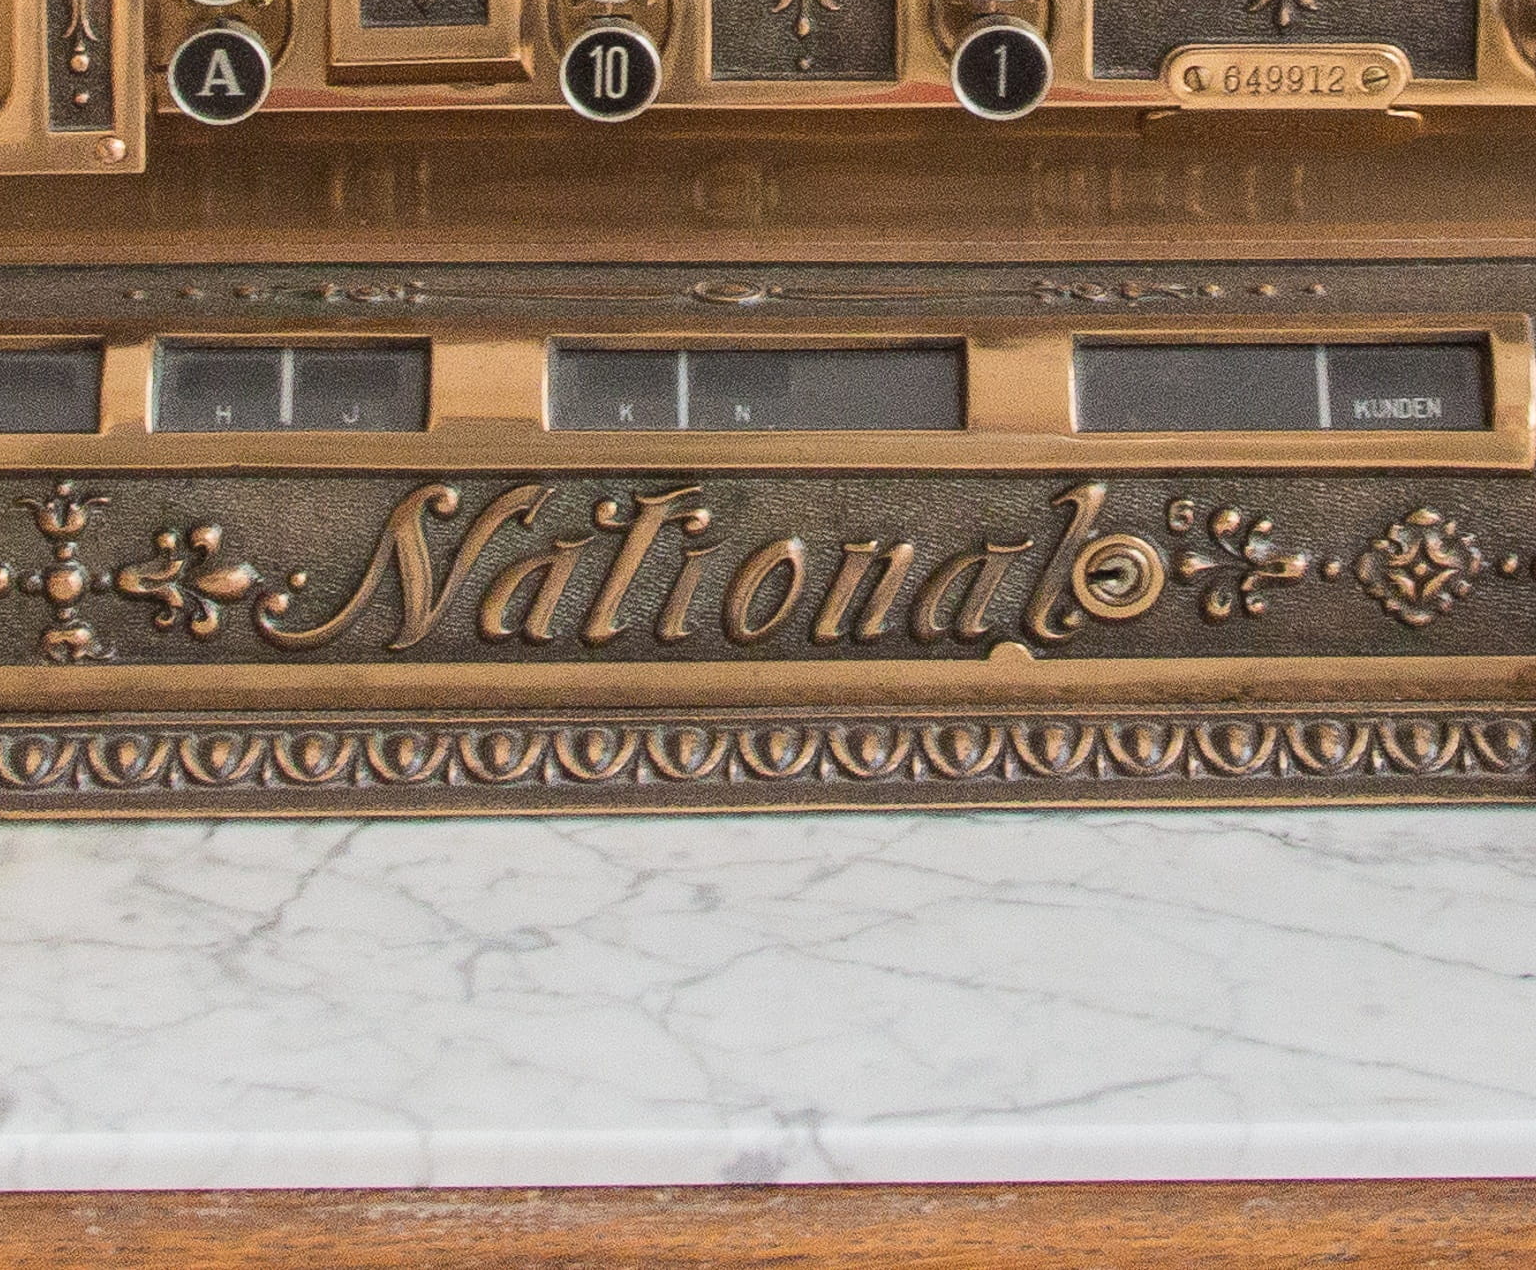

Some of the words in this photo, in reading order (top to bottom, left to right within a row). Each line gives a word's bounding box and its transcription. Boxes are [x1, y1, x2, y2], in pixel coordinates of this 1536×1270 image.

[195, 48, 245, 97] A
[590, 45, 629, 99] 10
[993, 44, 1008, 98] 1
[1222, 65, 1345, 95] 649912
[215, 404, 232, 425] H
[342, 404, 360, 425] J
[619, 404, 634, 422] K
[1353, 397, 1443, 419] KUNDEN
[265, 483, 1108, 652] National
